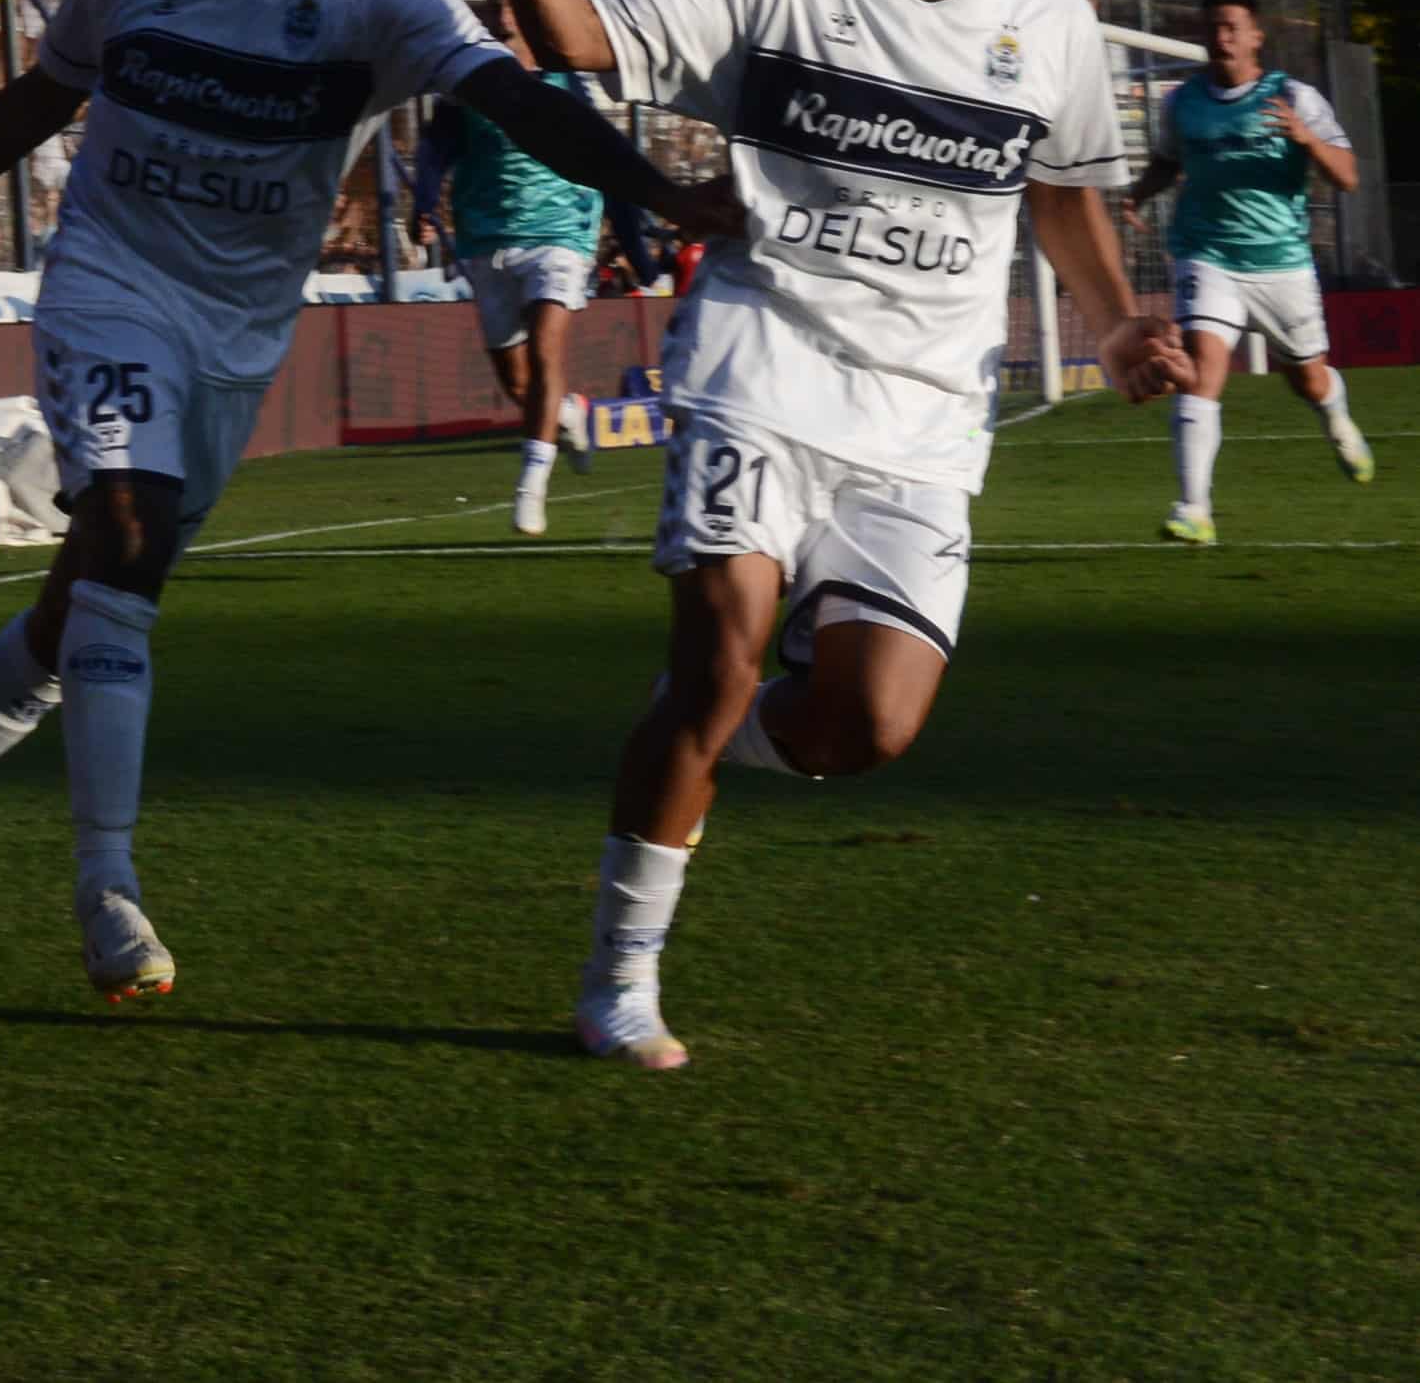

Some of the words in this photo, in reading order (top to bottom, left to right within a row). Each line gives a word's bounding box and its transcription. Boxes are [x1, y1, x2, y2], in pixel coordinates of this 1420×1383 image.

[109, 147, 290, 215] DELSUD
[835, 186, 947, 219] GRUPO
[777, 206, 975, 276] DELSUD
[86, 362, 153, 425] 25
[594, 405, 655, 448] LA
[702, 446, 771, 524] 21
